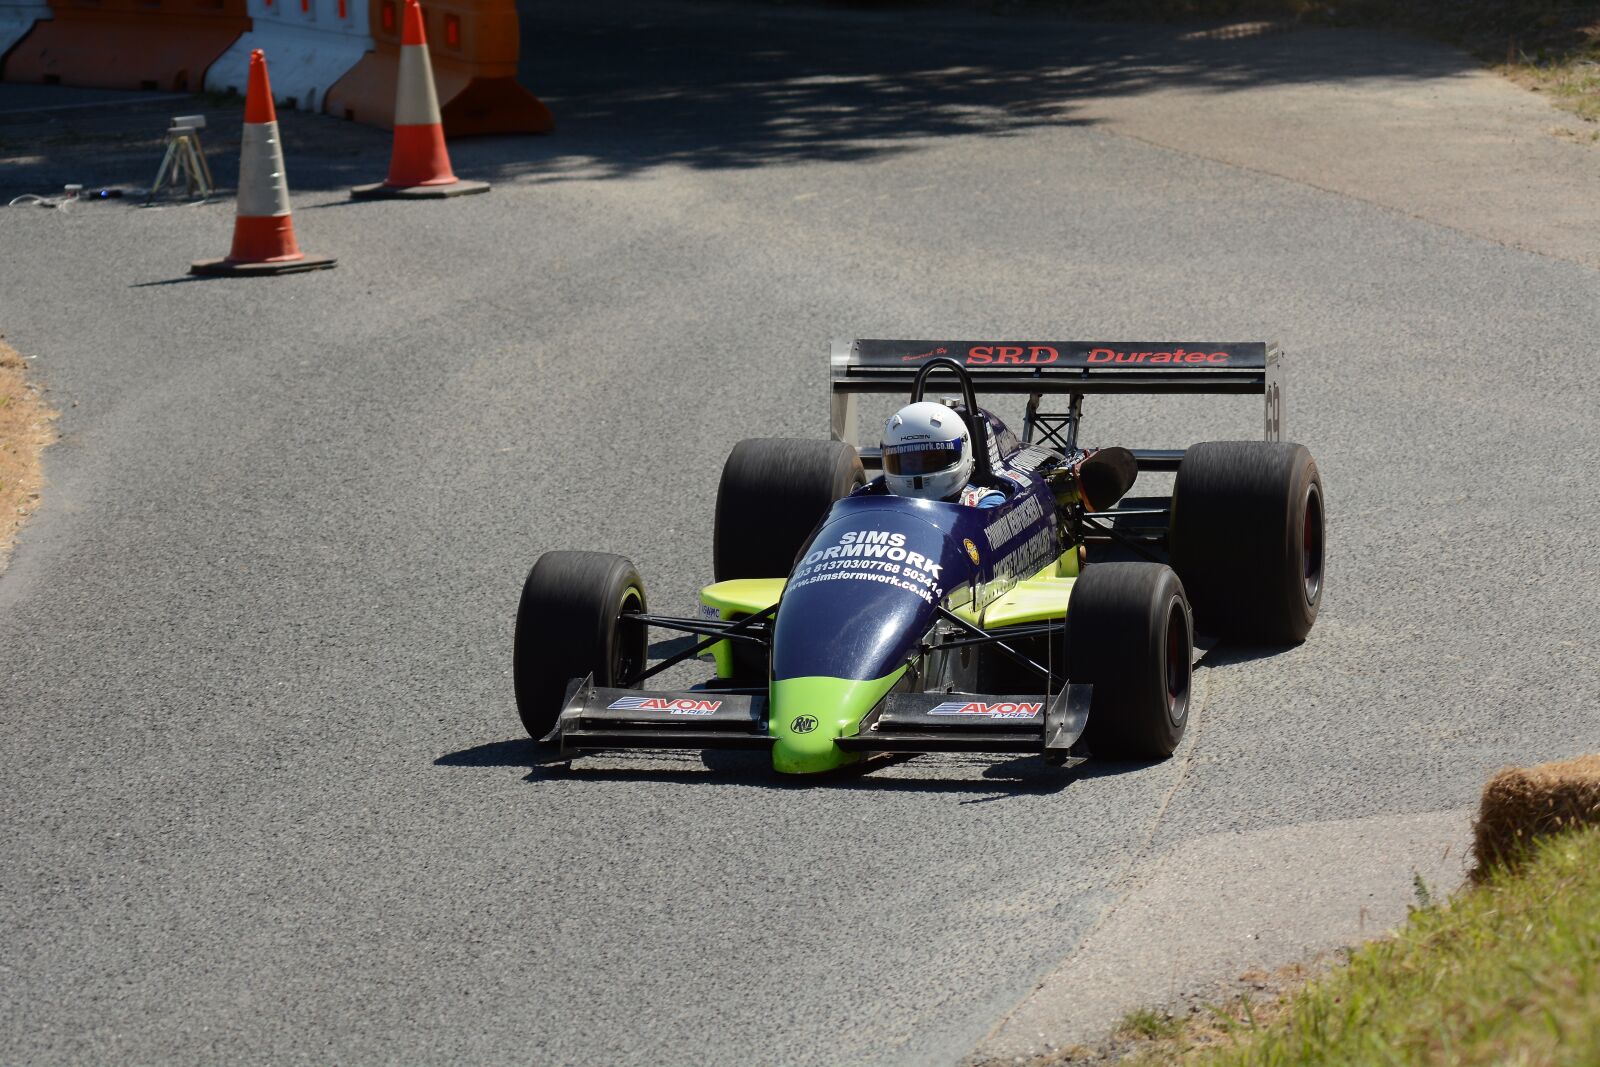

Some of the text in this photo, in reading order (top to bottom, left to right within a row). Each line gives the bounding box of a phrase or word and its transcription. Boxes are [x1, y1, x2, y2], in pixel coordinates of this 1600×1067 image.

[966, 346, 1059, 365] SRD
[1087, 348, 1230, 363] Duratec
[839, 530, 906, 547] SIMS
[813, 559, 900, 573] 813703/07768
[639, 699, 721, 711] AVON
[959, 703, 1042, 713] AVON
